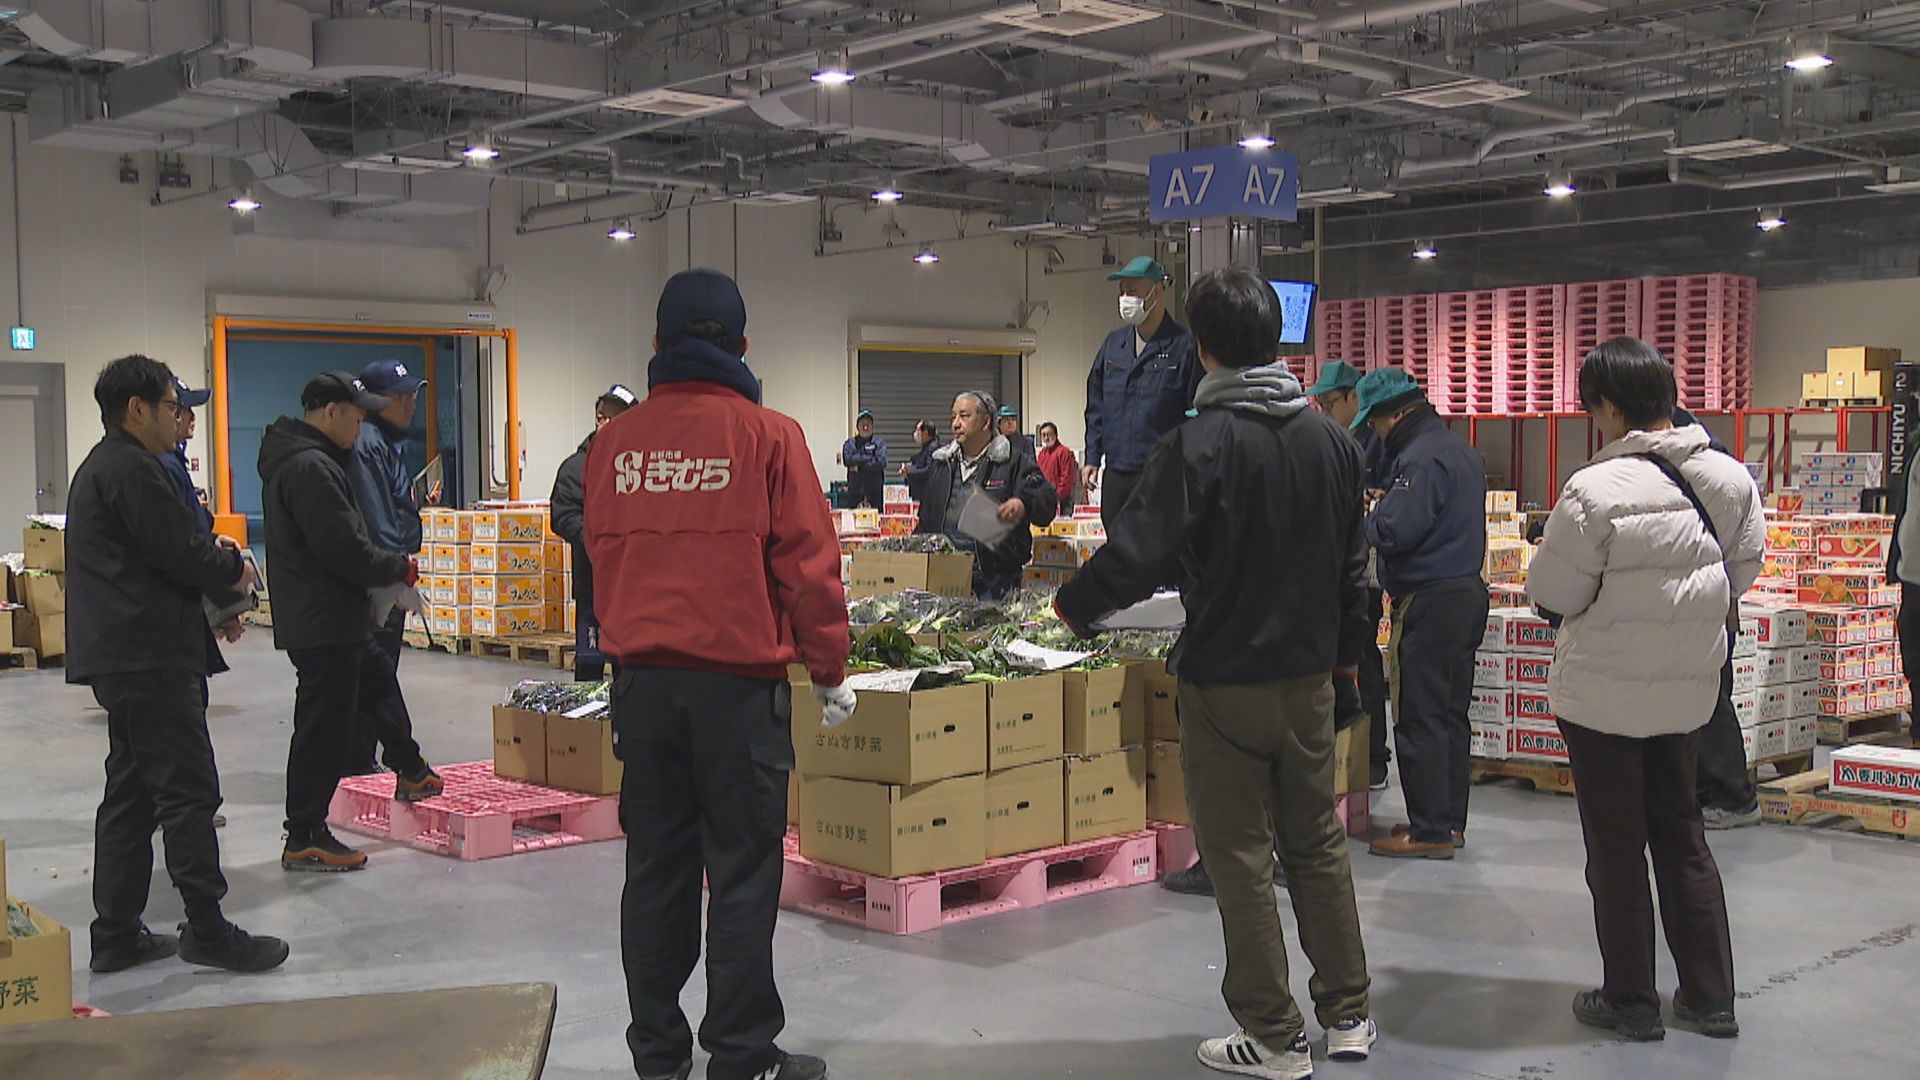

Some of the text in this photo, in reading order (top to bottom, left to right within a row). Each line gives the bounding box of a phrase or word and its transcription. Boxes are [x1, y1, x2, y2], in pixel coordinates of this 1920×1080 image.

[1164, 164, 1214, 208] A7
[1243, 164, 1285, 206] A7
[1890, 403, 1907, 474] NICHIYU
[644, 458, 731, 492] きむら
